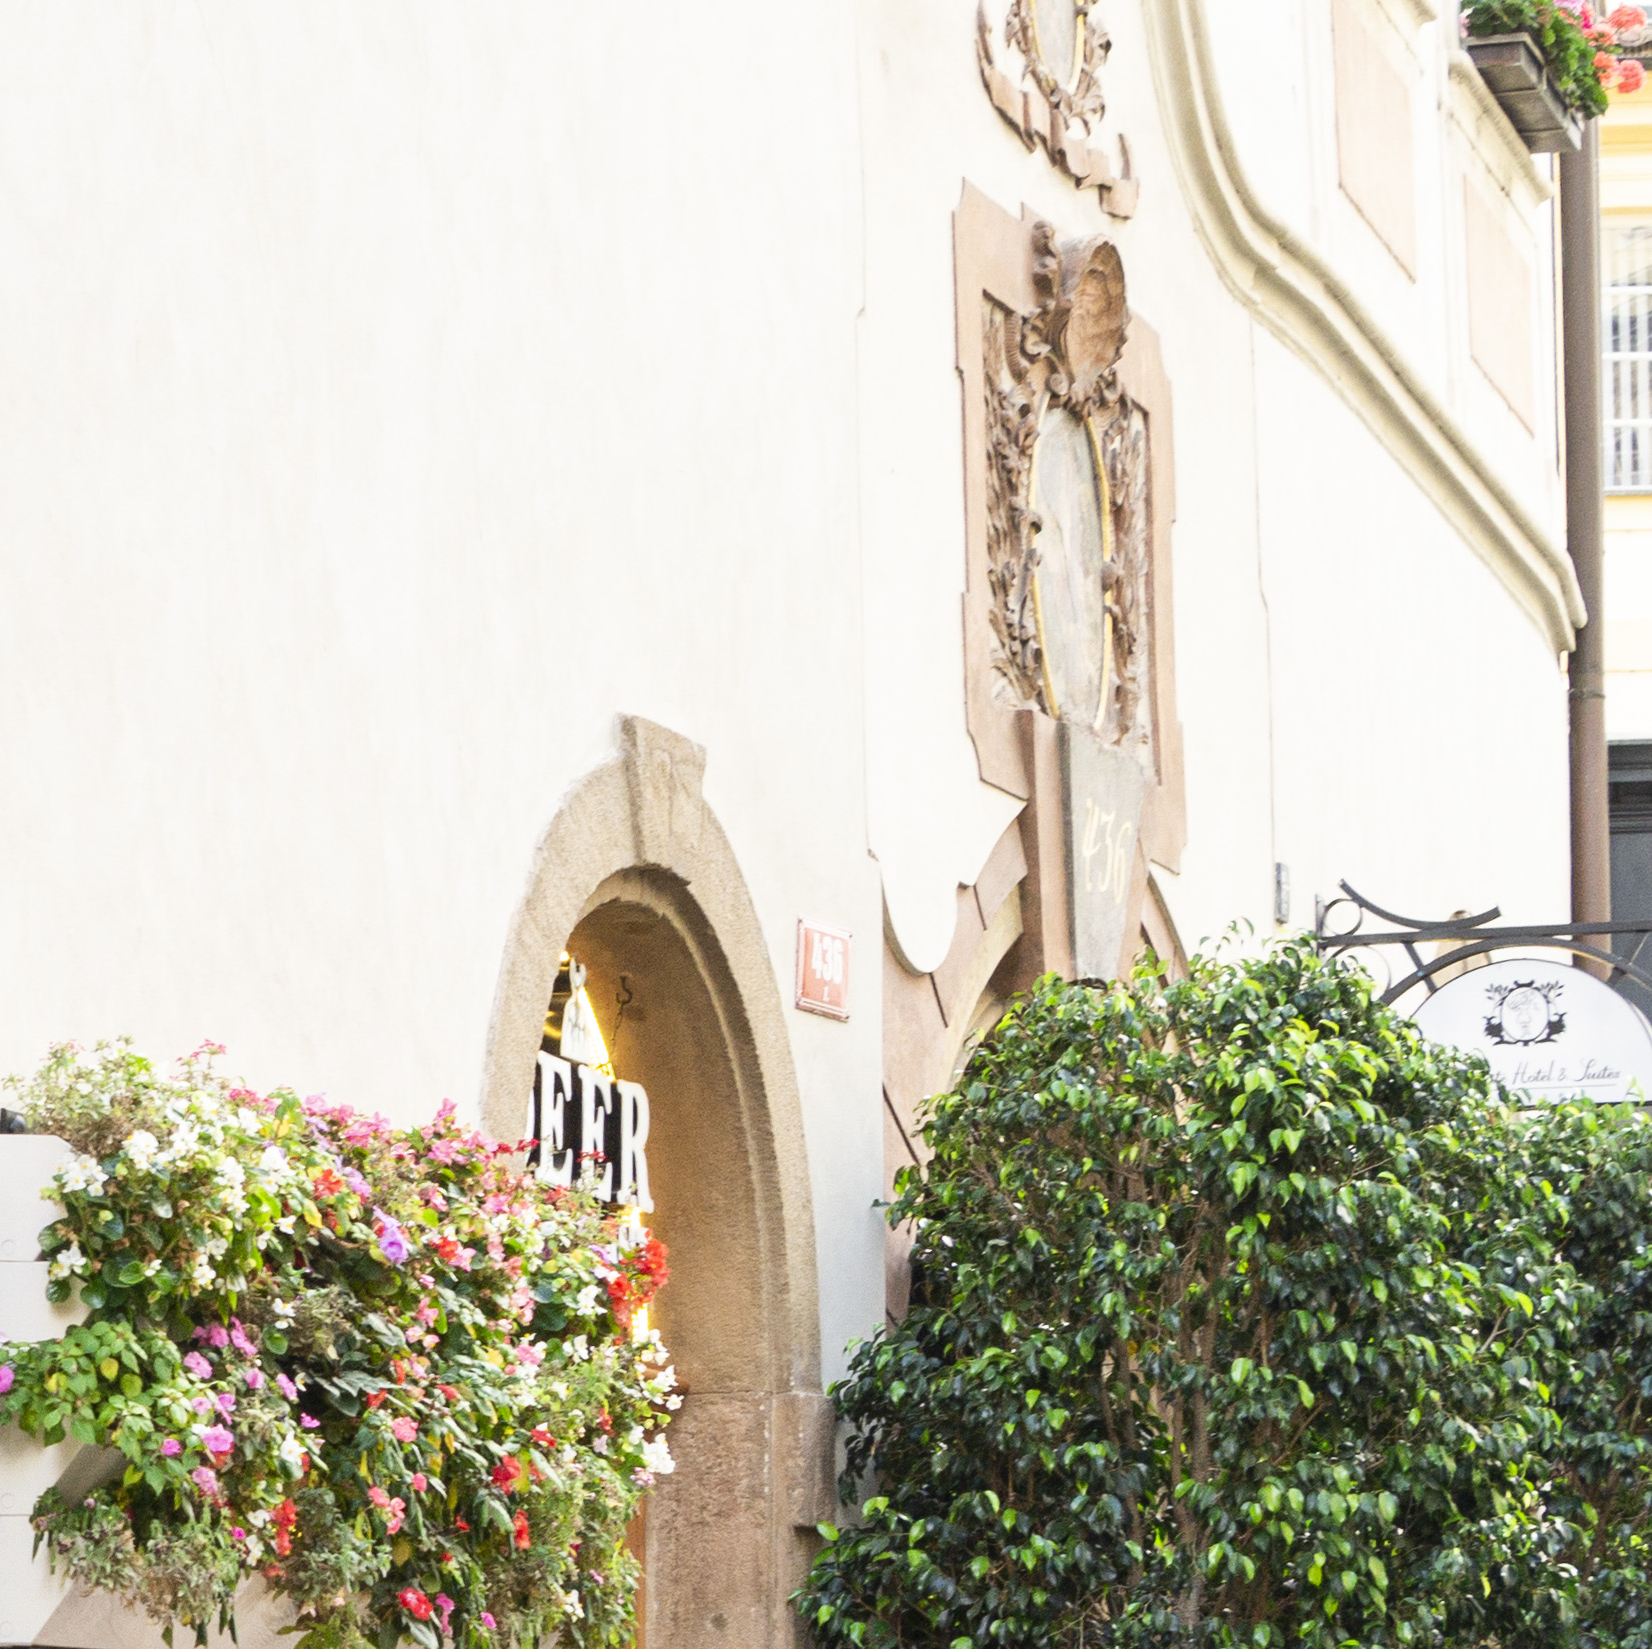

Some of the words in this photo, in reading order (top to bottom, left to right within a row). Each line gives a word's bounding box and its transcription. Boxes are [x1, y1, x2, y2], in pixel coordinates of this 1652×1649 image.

[1082, 798, 1132, 905] 436
[810, 933, 844, 985] 436
[1512, 1059, 1555, 1085] Hotel
[1574, 1058, 1622, 1082] Suites
